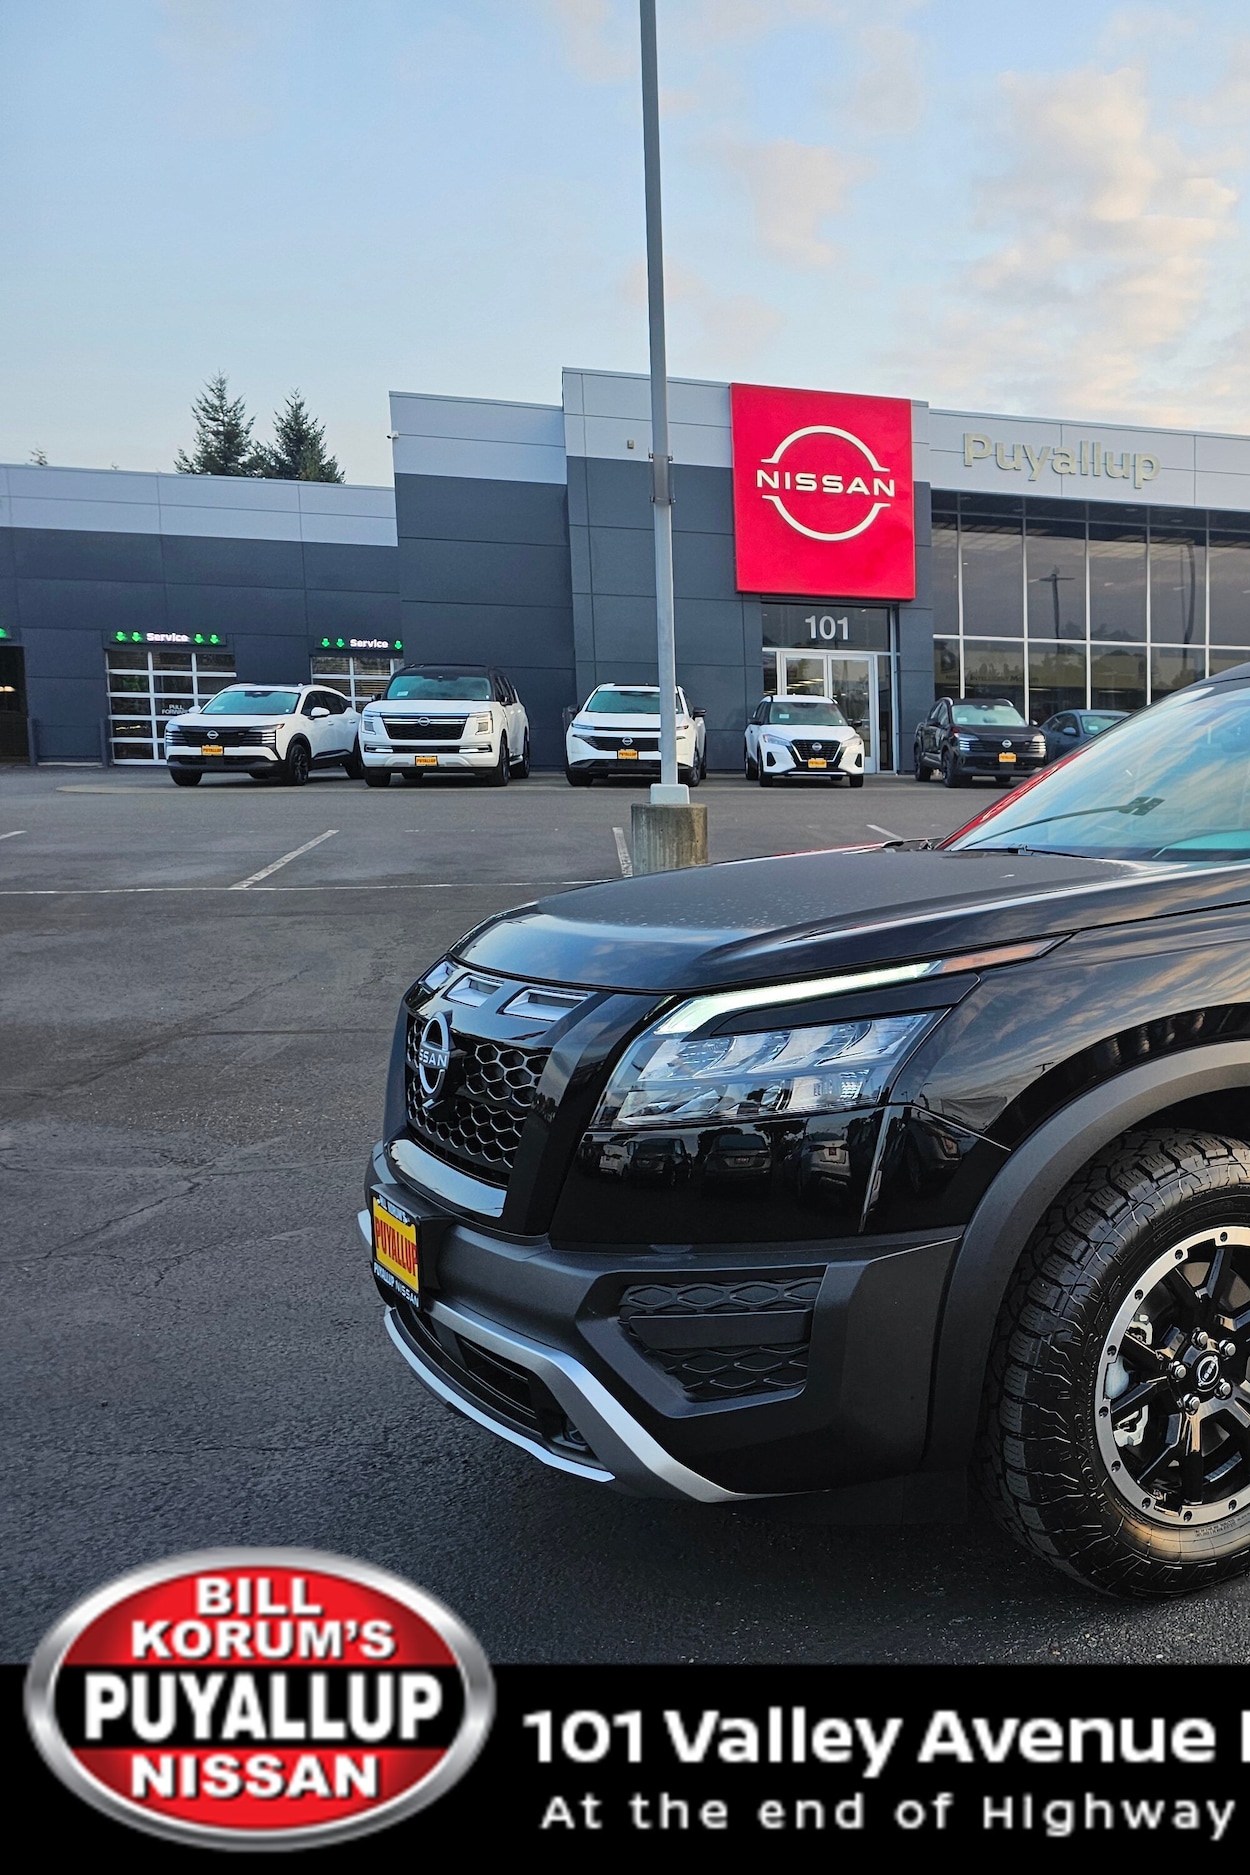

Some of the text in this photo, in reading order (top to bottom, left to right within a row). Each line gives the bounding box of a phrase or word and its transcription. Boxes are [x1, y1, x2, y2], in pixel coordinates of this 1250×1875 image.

[963, 433, 1161, 489] Puyallup
[757, 469, 895, 497] NISSAN
[146, 632, 190, 642] Service
[805, 615, 849, 640] 101
[349, 639, 389, 649] Service
[419, 1048, 448, 1068] SSAN
[375, 1215, 418, 1278] PUYALLUP
[395, 1279, 419, 1308] NISSAN
